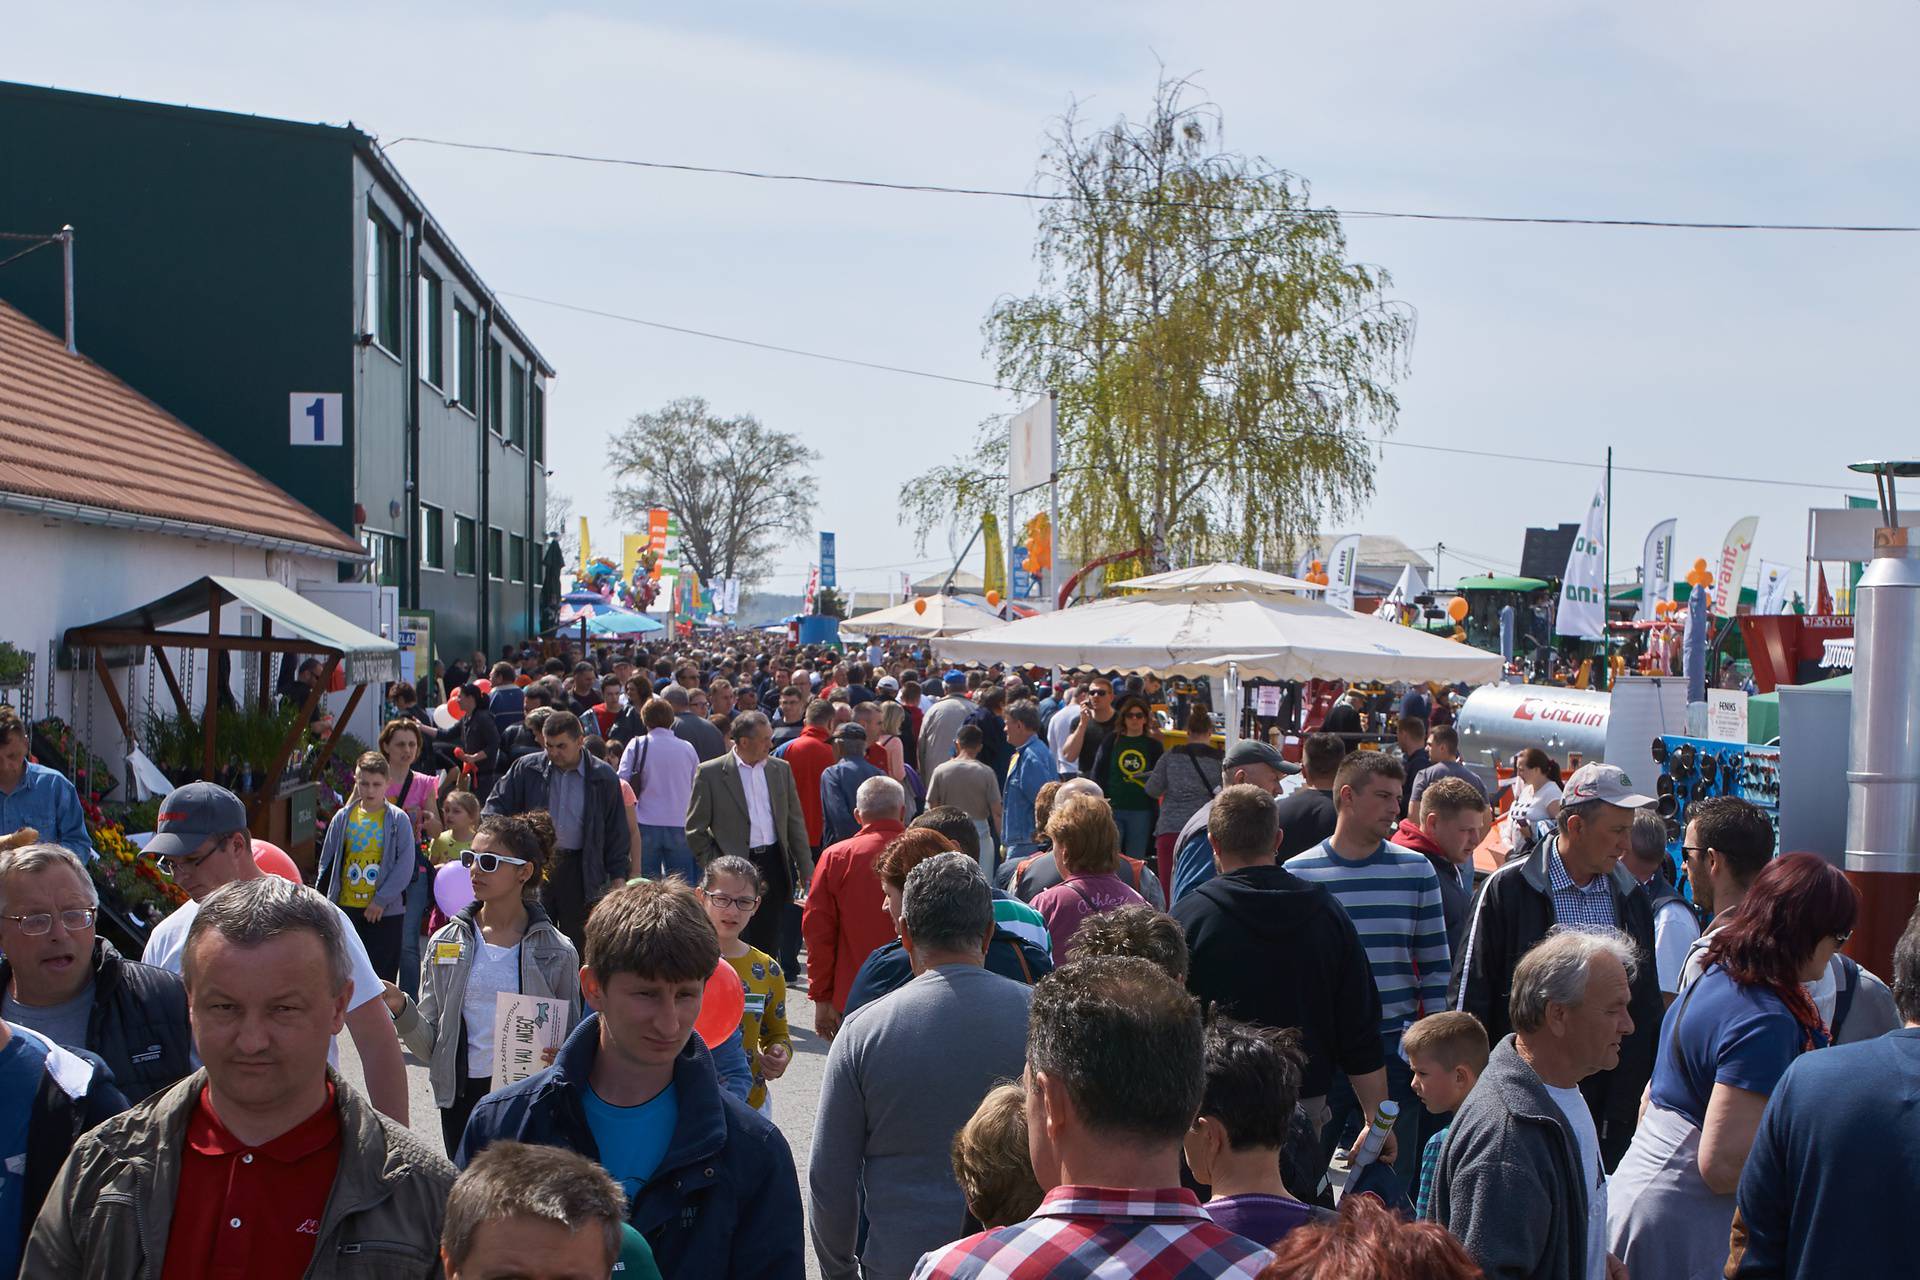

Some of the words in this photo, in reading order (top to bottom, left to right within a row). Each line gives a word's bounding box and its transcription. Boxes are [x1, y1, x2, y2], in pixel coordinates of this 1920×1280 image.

[306, 398, 325, 441] 1
[1338, 550, 1347, 582] FAHR
[1655, 540, 1665, 578] FAHR
[513, 1048, 533, 1064] VAU
